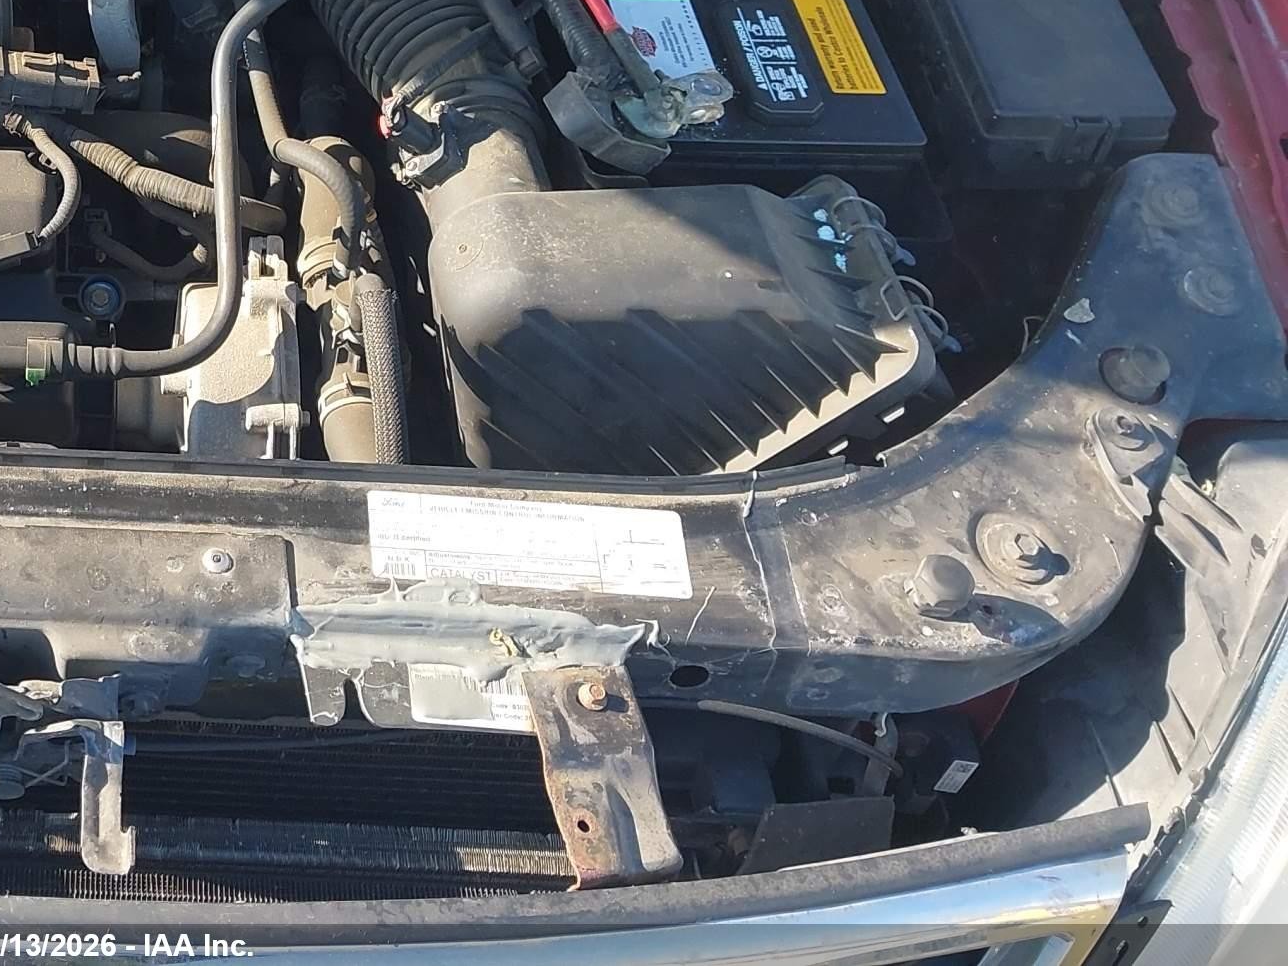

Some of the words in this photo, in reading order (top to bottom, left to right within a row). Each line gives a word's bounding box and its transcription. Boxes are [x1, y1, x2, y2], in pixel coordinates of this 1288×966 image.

[732, 20, 751, 46] POISON
[746, 52, 764, 82] DANGER
[431, 568, 492, 581] CATALYST
